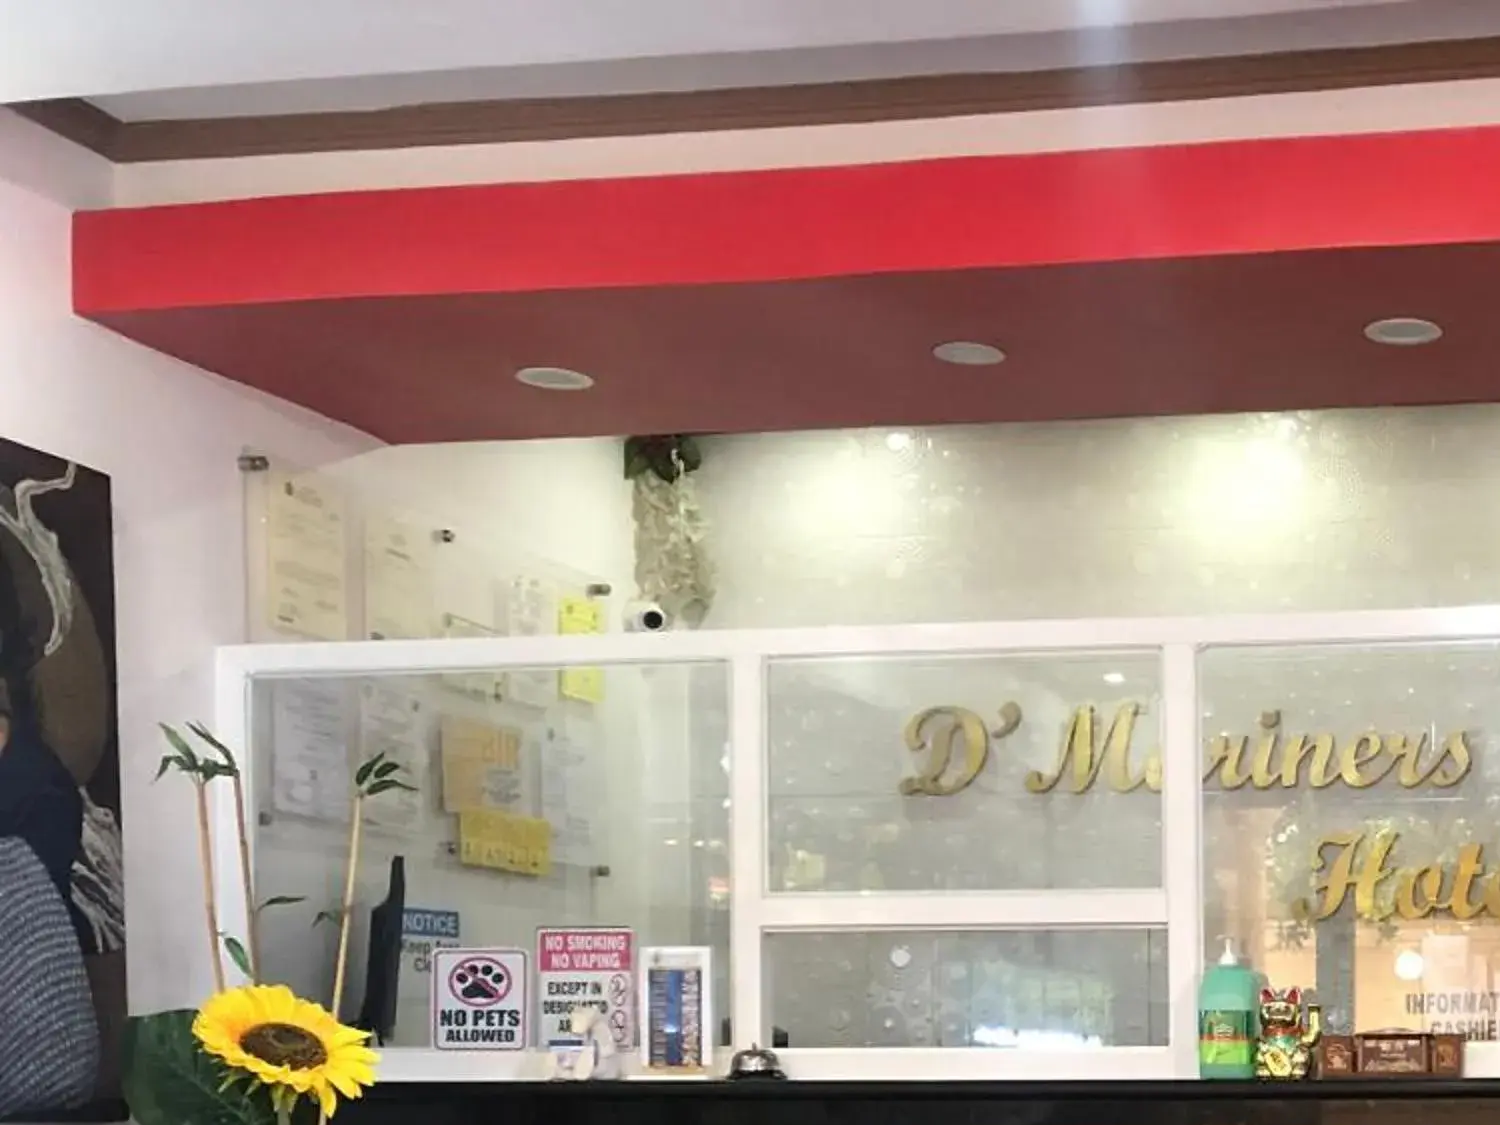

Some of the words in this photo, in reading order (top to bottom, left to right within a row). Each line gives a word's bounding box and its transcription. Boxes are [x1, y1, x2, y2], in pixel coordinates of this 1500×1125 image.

[402, 913, 457, 934] NOTICE
[545, 936, 562, 950] NO
[567, 935, 626, 950] SMOKING
[551, 954, 569, 968] NO
[574, 953, 621, 968] VAPING
[548, 982, 588, 995] EXCEPT
[591, 981, 602, 994] IN
[440, 1009, 467, 1026] NO
[472, 1009, 520, 1026] PETS
[445, 1029, 515, 1042] ALLOWED
